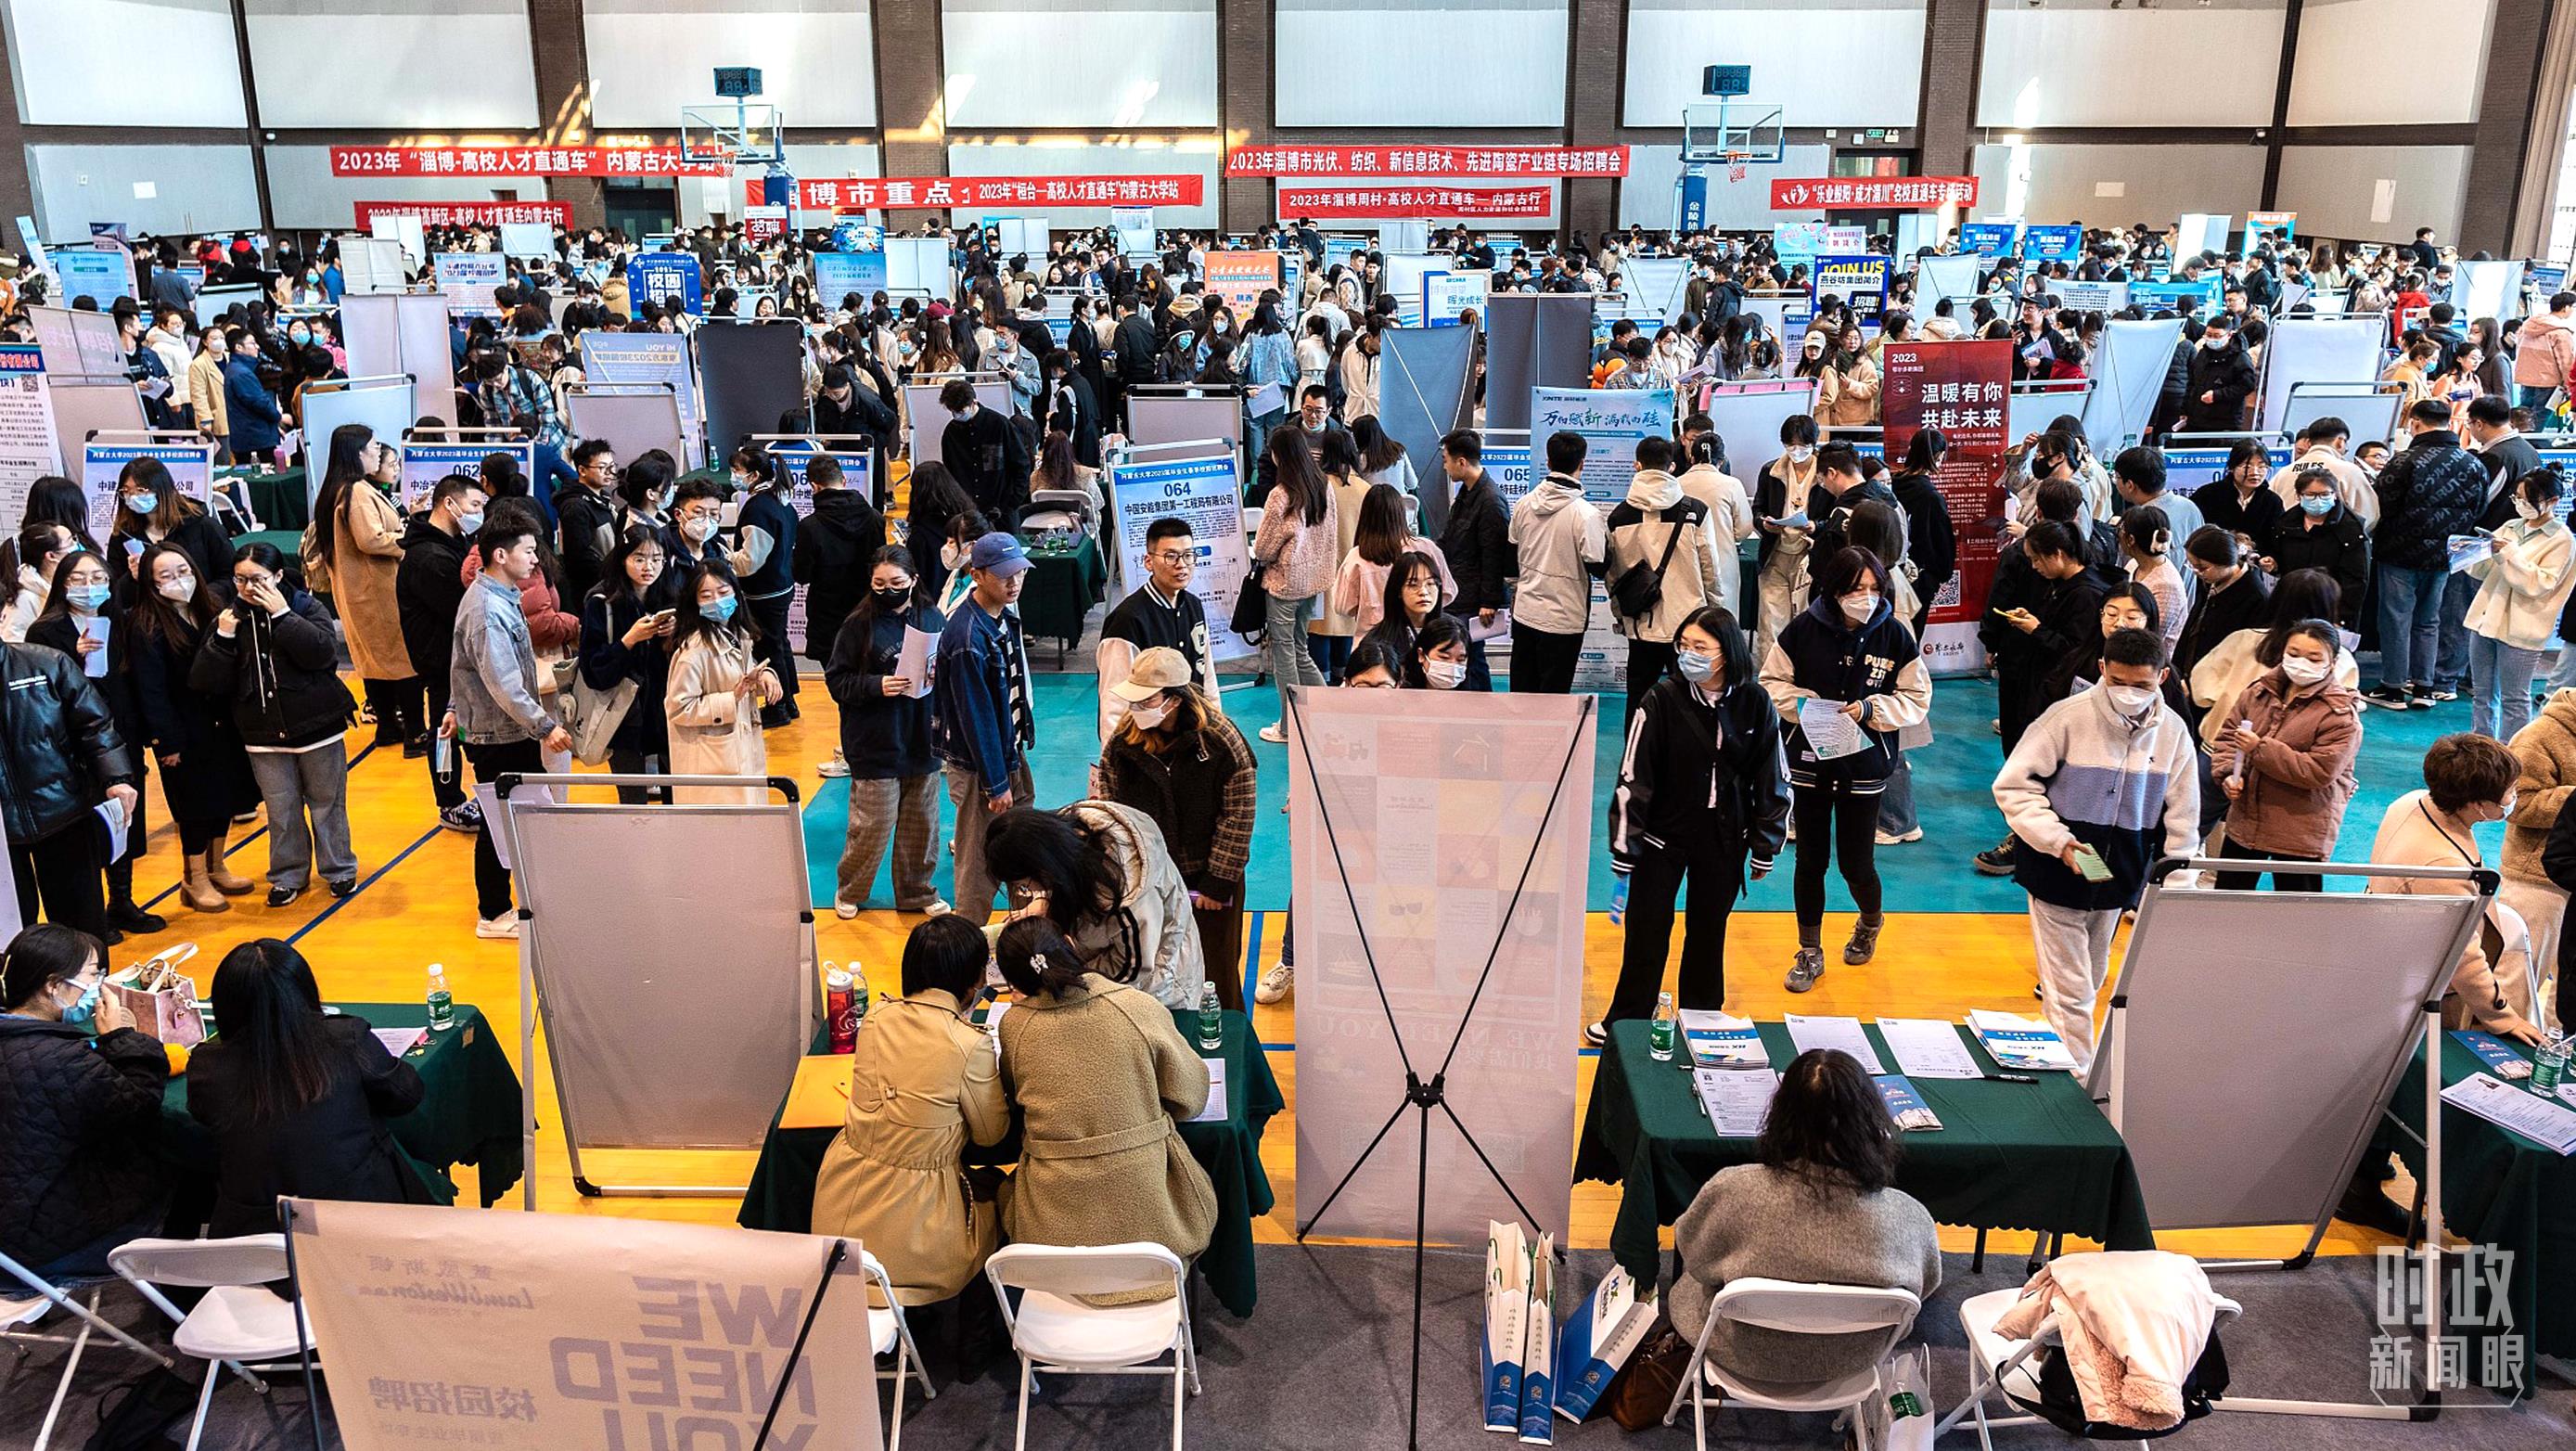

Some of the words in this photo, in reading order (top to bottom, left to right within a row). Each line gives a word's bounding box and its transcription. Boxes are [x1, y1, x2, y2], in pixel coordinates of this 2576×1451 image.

[1230, 150, 1621, 173] 2023年淄博市光伏、纺织、新信息技术、先进陶瓷产业链专场招聘会
[789, 182, 970, 205] 博市重点
[1863, 260, 1886, 274] US
[1892, 353, 1917, 363] 2023
[1921, 381, 2003, 404] 温暖有你
[1921, 408, 2002, 430] 共赴未来
[453, 465, 481, 478] 062
[1504, 469, 1530, 482] 065
[1164, 482, 1191, 496] 064
[1124, 494, 1234, 516] 中国安能集团第一工程局有限公司
